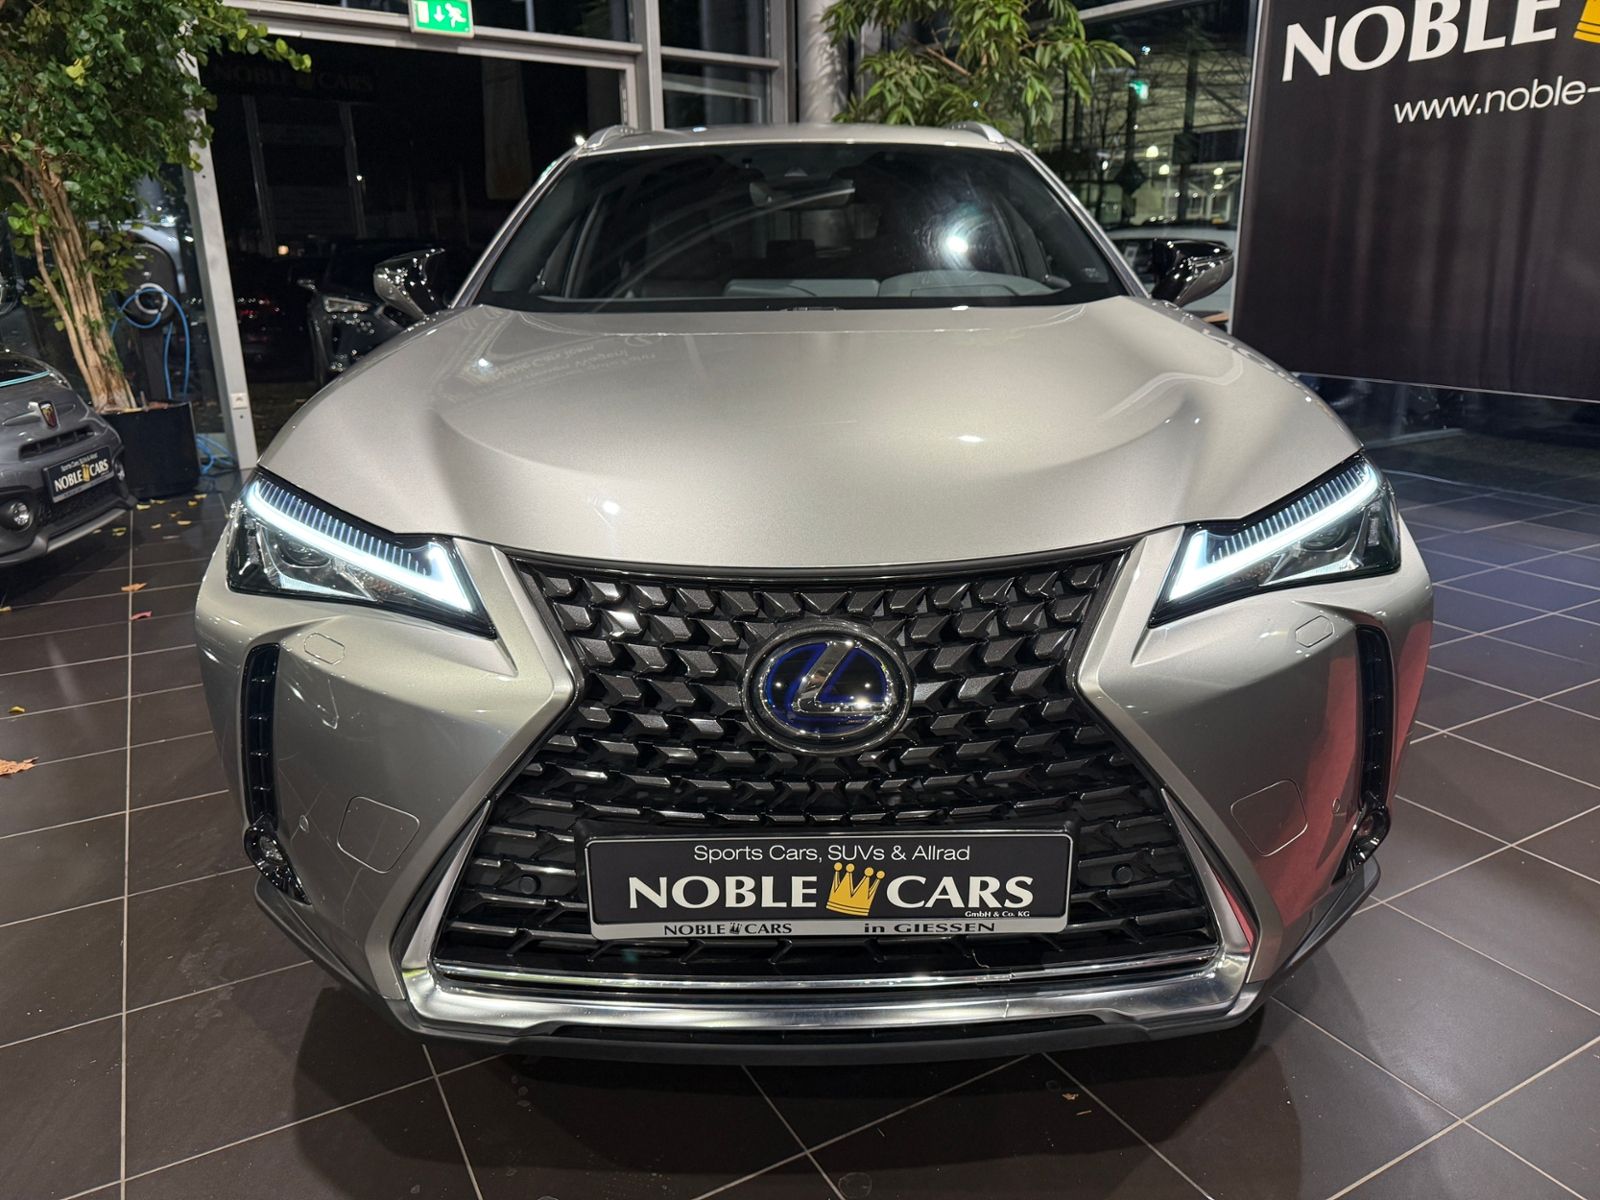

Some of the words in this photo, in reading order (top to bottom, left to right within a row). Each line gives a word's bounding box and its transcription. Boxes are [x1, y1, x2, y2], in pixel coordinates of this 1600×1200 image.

[1282, 0, 1563, 82] NOBLE
[1394, 75, 1600, 124] www.noble-
[54, 470, 82, 492] NOBLE
[89, 459, 109, 476] CARS
[693, 844, 763, 864] Sports
[769, 844, 823, 864] Cars,
[827, 844, 885, 861] SUVs
[890, 845, 907, 861] &
[912, 844, 971, 861] Allrad
[628, 875, 818, 909] NOBLE
[886, 875, 1035, 909] CARS
[663, 923, 726, 936] NOBLE
[744, 922, 793, 935] CARS
[863, 923, 885, 934] in
[893, 923, 995, 933] GIESSEN
